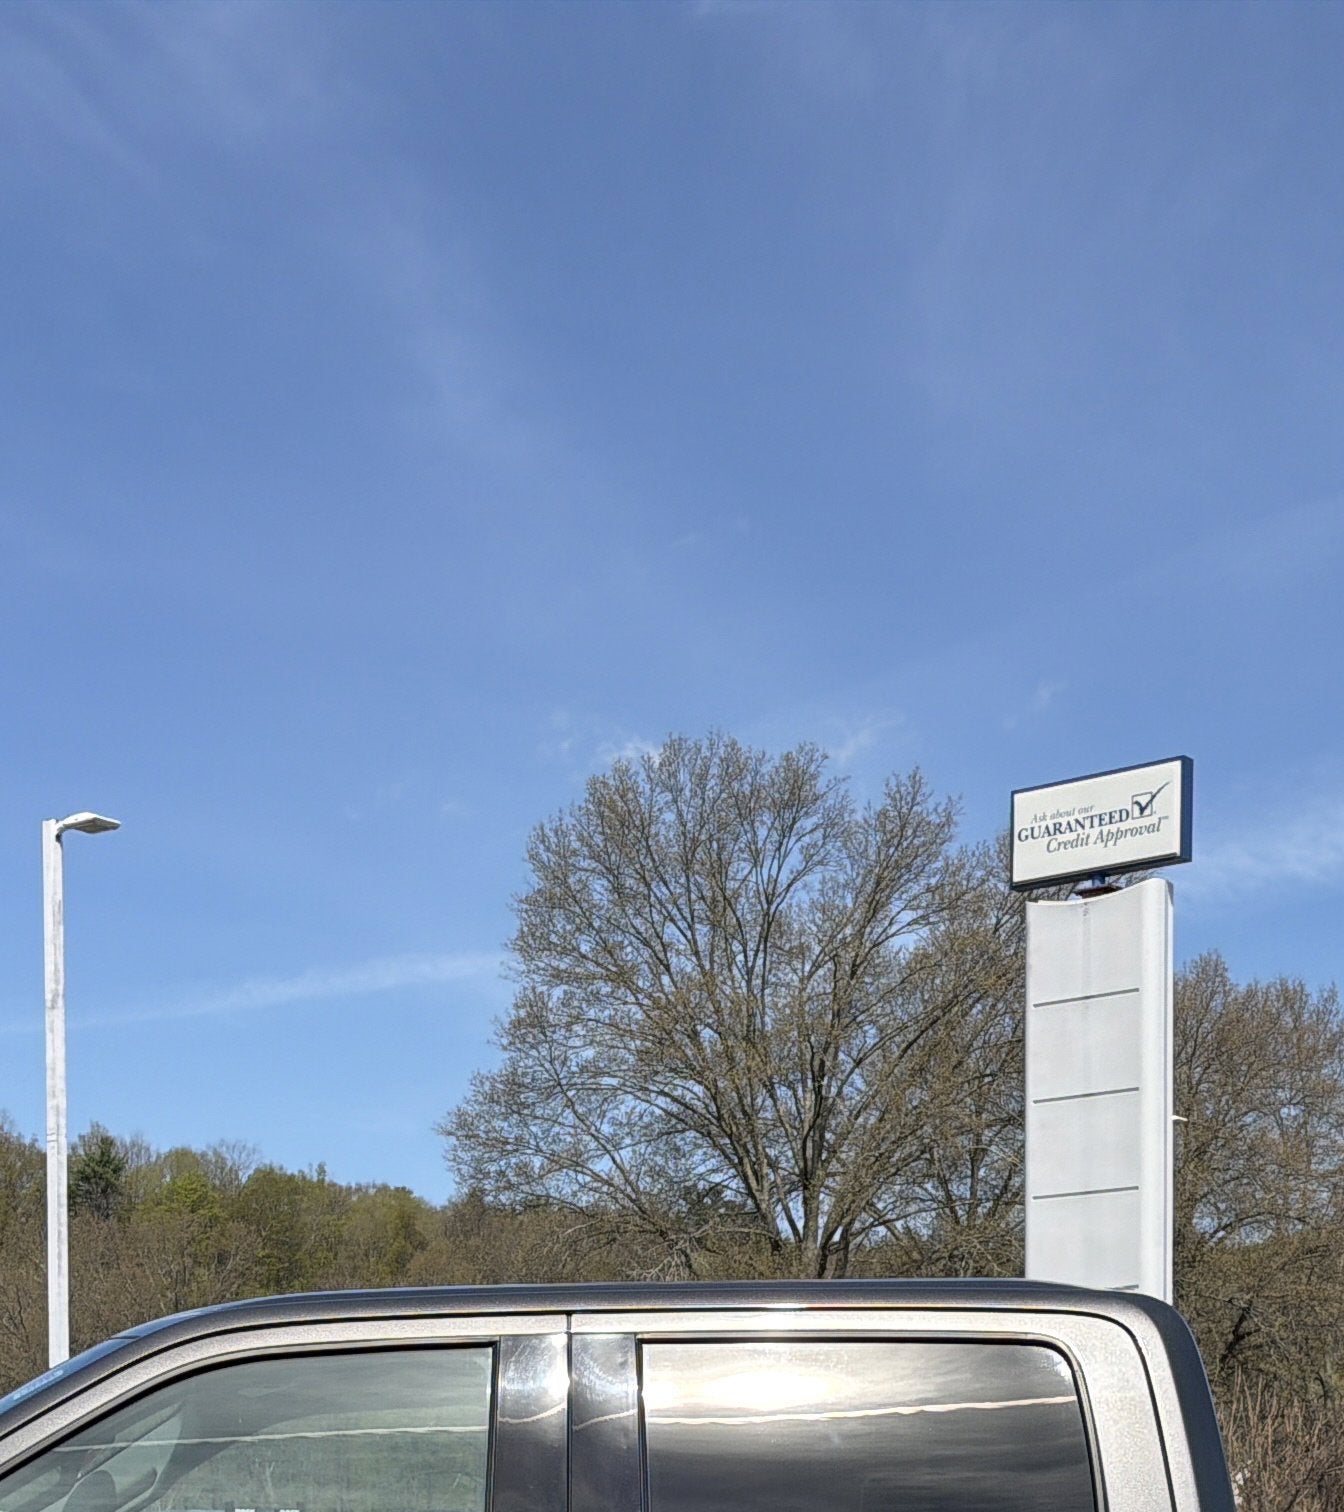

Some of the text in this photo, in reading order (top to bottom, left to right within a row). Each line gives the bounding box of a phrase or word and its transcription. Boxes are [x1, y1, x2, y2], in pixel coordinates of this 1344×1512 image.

[1017, 807, 1130, 843] GUARANTEED
[1031, 804, 1095, 823] Ask about our
[1046, 816, 1162, 854] Credit Approval
